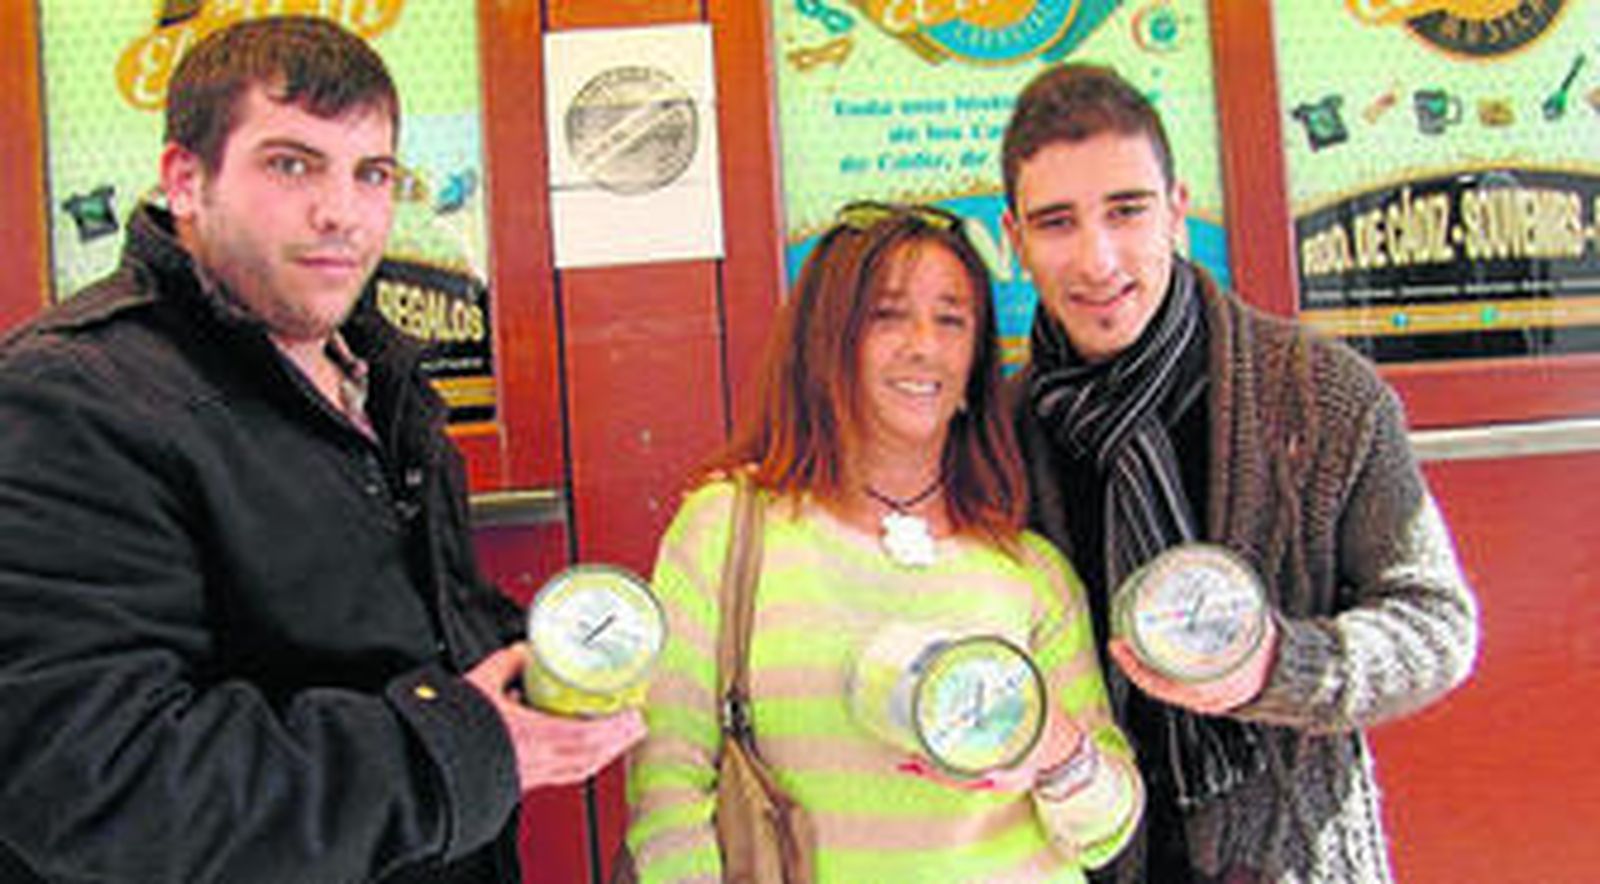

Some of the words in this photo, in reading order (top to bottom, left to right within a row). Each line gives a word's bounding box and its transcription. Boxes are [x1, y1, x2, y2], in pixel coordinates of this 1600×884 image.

[1353, 208, 1387, 270] DE
[1461, 185, 1583, 261] SOUVENIRS
[375, 278, 485, 343] REGALOS
